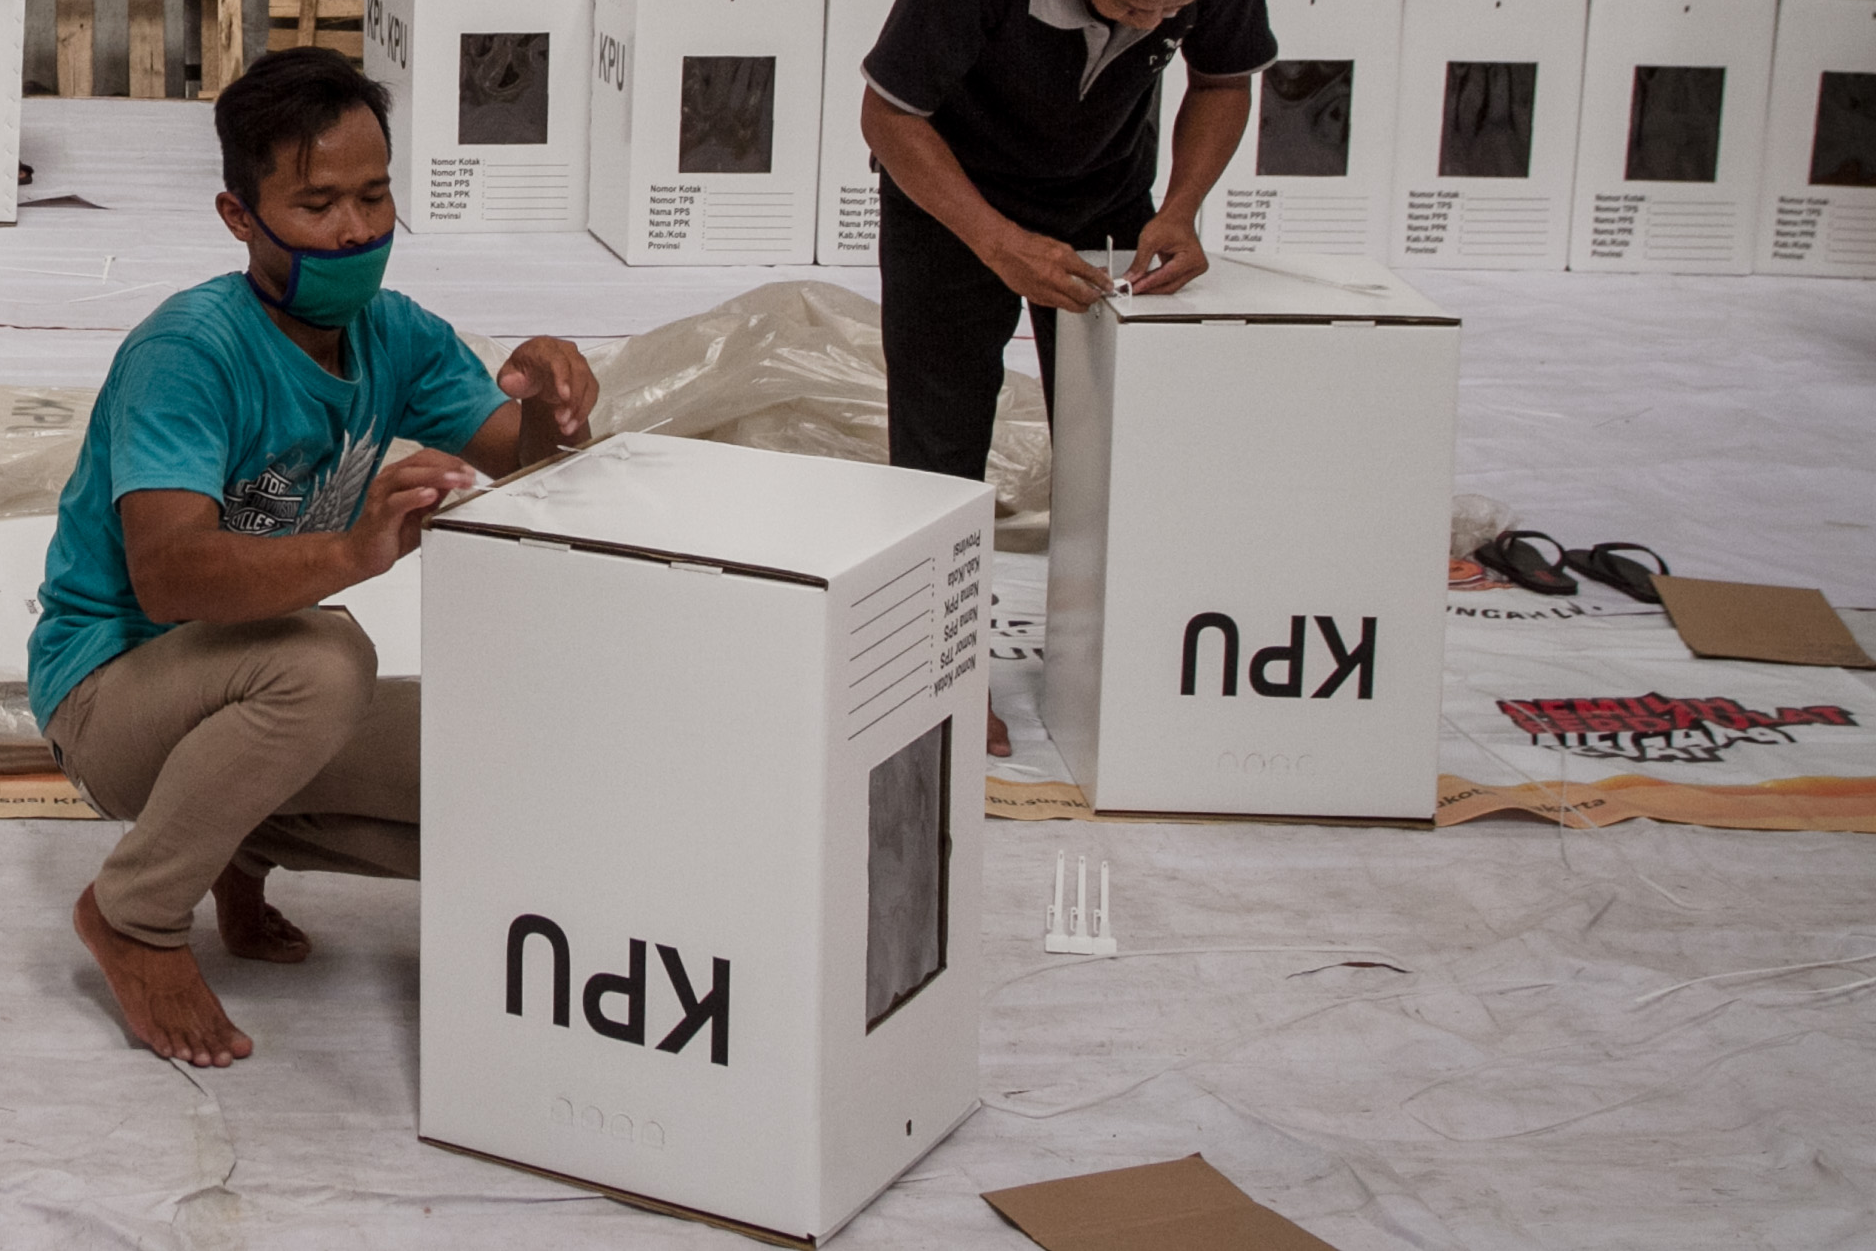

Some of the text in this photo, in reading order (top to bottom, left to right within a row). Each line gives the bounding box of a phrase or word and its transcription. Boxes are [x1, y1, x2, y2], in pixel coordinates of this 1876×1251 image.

[388, 13, 408, 69] KPU
[599, 33, 626, 91] KPU
[431, 157, 481, 166] Nomor Kotak
[431, 168, 474, 177] Nomor TPS
[430, 179, 470, 188] Nama PPS
[430, 189, 470, 199] Nama PPK
[650, 184, 702, 194] Nomor Kotak
[649, 195, 695, 205] Nomor TPS
[1408, 190, 1460, 200] Nomor Kotak
[430, 201, 467, 209] Kab./Kota
[1407, 201, 1453, 210] Nomor TPS
[430, 211, 461, 220] Provinsi
[649, 207, 691, 216] Nama PPS
[1407, 212, 1449, 221] Nama PPS
[649, 218, 690, 228] Nama PPK
[1406, 223, 1448, 232] Nama PPK
[648, 230, 687, 239] Kab./Kota
[647, 241, 680, 250] Provinsi
[1405, 245, 1438, 255] Provinsi
[231, 510, 276, 531] CYCLES
[953, 529, 981, 563] Provinsi
[947, 554, 981, 587] Kab./Kota
[944, 580, 980, 618] Nama PPK
[959, 604, 978, 629] Nama
[943, 618, 959, 642] PPS
[954, 629, 977, 656] Nomor
[939, 646, 954, 670] TPS
[1181, 612, 1377, 699] KPU
[954, 653, 977, 680] Nomor
[933, 668, 954, 697] Kotak
[985, 792, 1090, 809] pu.surak
[506, 914, 730, 1066] KPU
